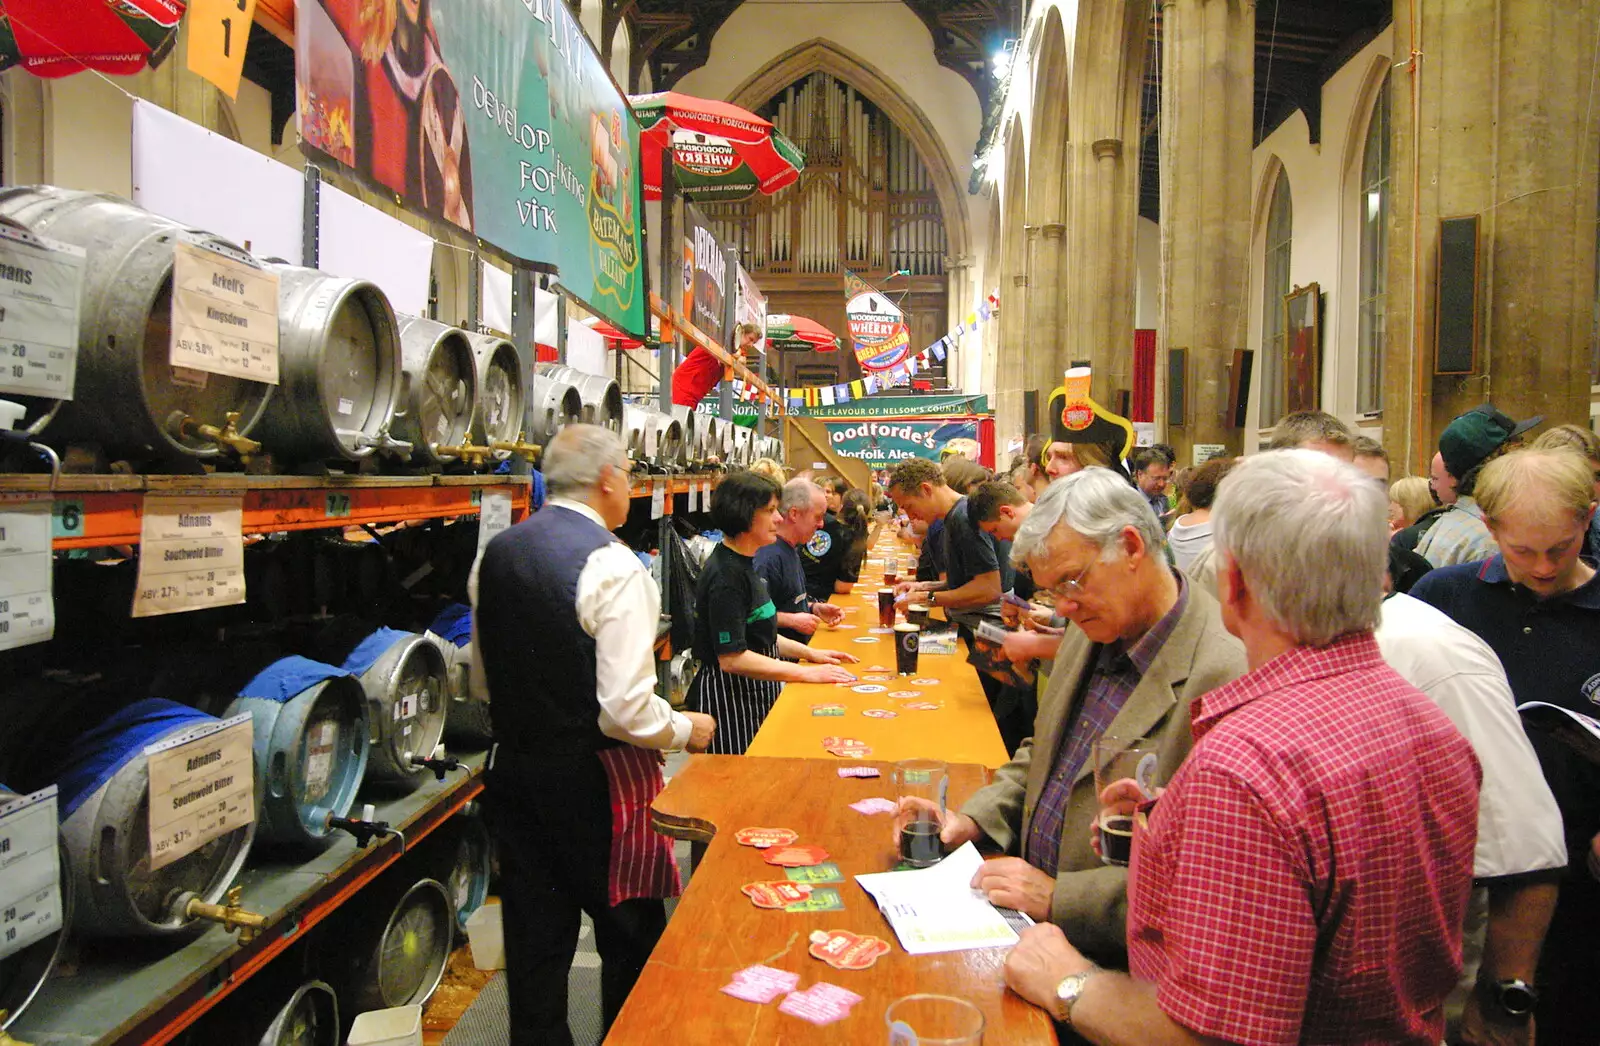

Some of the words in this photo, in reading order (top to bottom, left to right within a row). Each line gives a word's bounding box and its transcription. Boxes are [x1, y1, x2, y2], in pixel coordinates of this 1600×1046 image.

[212, 272, 245, 295] Arkell's
[206, 306, 248, 329] Kingsdown
[850, 322, 895, 335] WHERRY
[12, 344, 26, 358] 20
[12, 365, 24, 378] 10
[808, 408, 825, 416] THE
[827, 408, 866, 416] FLAVOUR
[868, 407, 880, 415] OF
[883, 406, 925, 415] NELSON'S
[828, 422, 937, 449] oodforde's
[888, 450, 916, 460] Ales
[177, 513, 213, 528] Adnams
[186, 750, 222, 772] Adnams
[172, 784, 214, 810] Southwold
[213, 775, 234, 792] Bitter
[218, 800, 227, 812] 20
[4, 907, 17, 924] 20
[5, 926, 17, 942] 10
